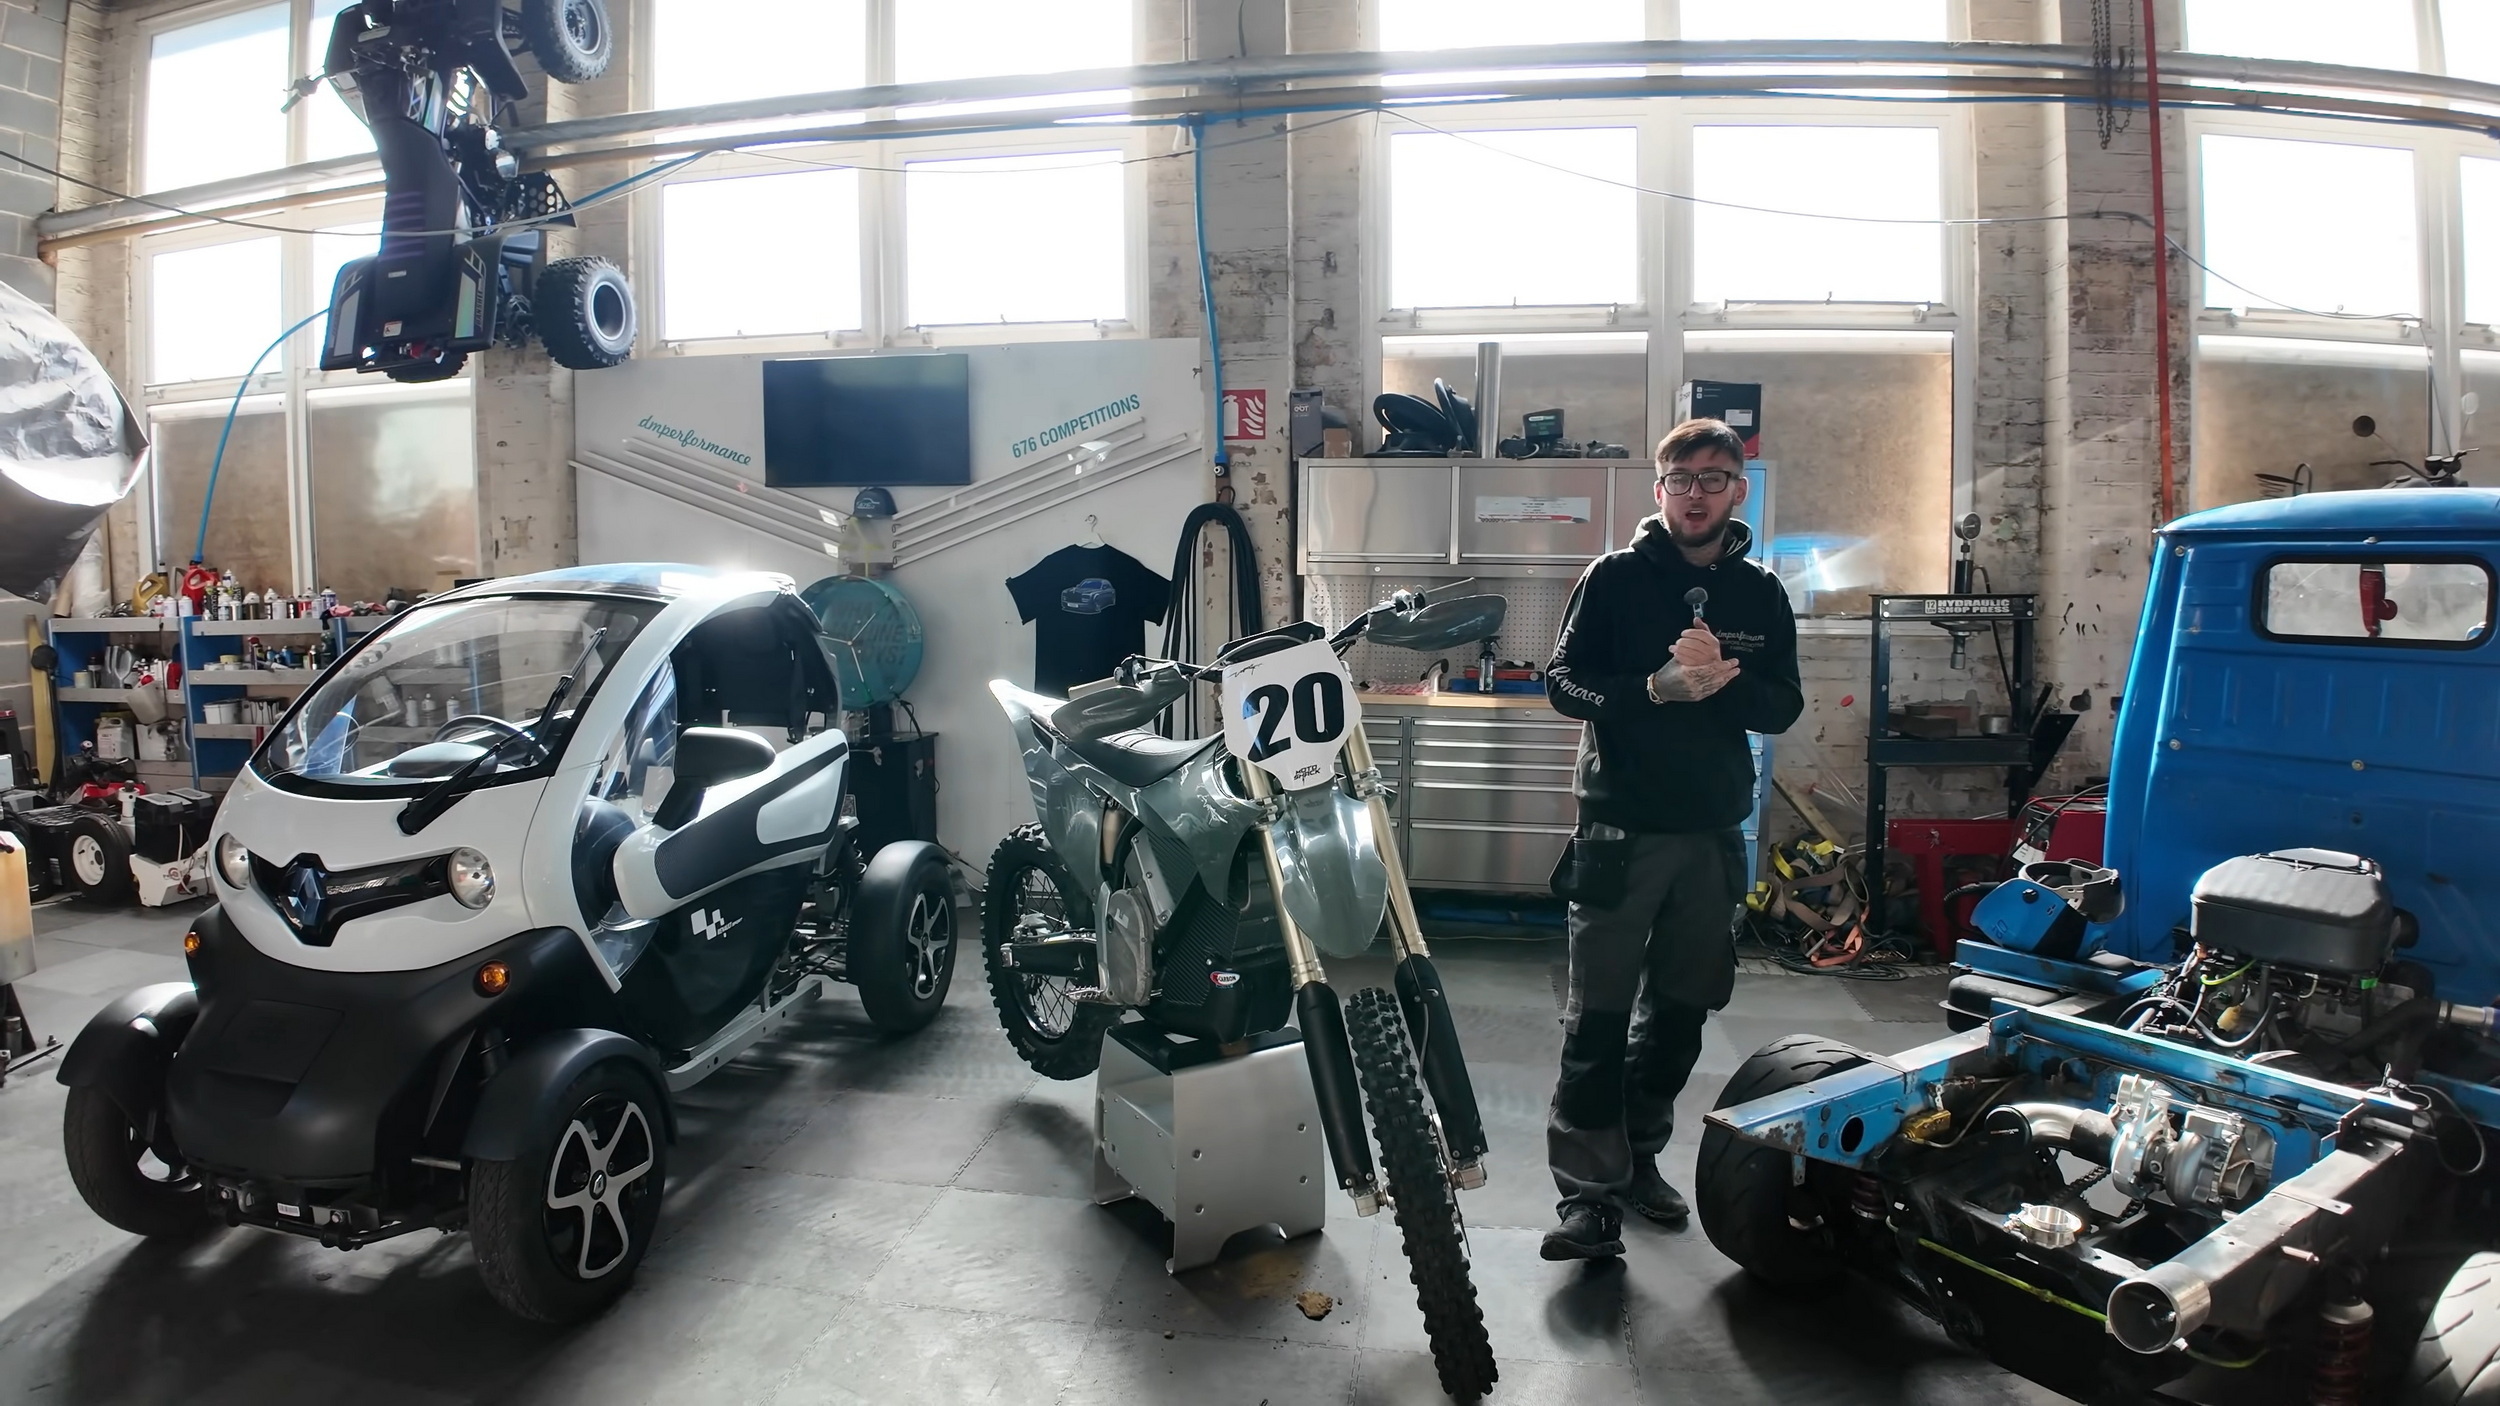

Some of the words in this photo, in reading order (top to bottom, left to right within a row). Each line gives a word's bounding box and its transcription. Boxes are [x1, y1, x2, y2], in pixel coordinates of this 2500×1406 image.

[1012, 437, 1037, 458] 676
[1040, 394, 1140, 447] COMPETITIONS
[638, 415, 751, 465] dmperformance
[1926, 600, 1935, 609] 12
[1938, 599, 2010, 607] HYDRAULIC
[1242, 671, 1345, 763] 20
[1293, 767, 1321, 781] SHACK
[1295, 764, 1317, 775] MOTO
